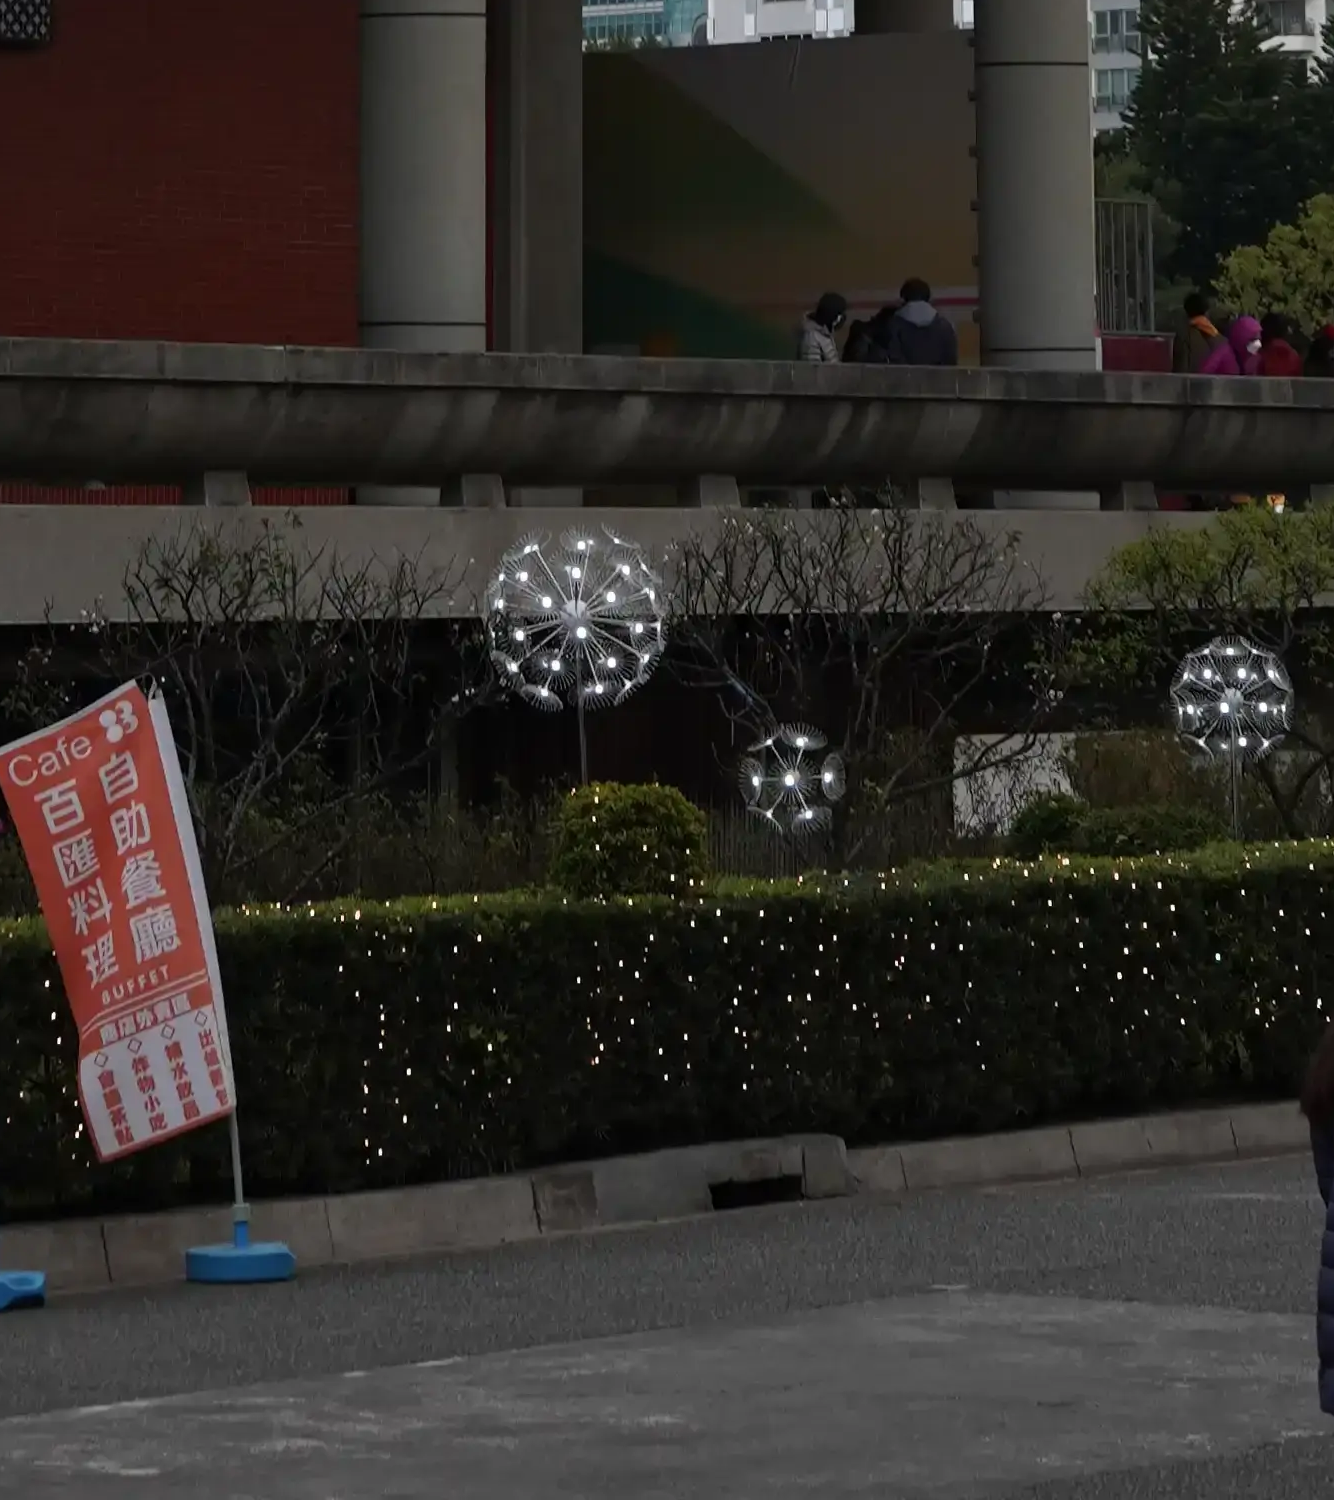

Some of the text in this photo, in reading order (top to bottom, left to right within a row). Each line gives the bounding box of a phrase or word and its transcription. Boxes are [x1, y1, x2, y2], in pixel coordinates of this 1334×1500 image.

[8, 731, 92, 787] Cafe
[34, 778, 119, 989] 百匯料理
[98, 750, 180, 966] 自助餐廳
[101, 965, 170, 1005] BUFFET
